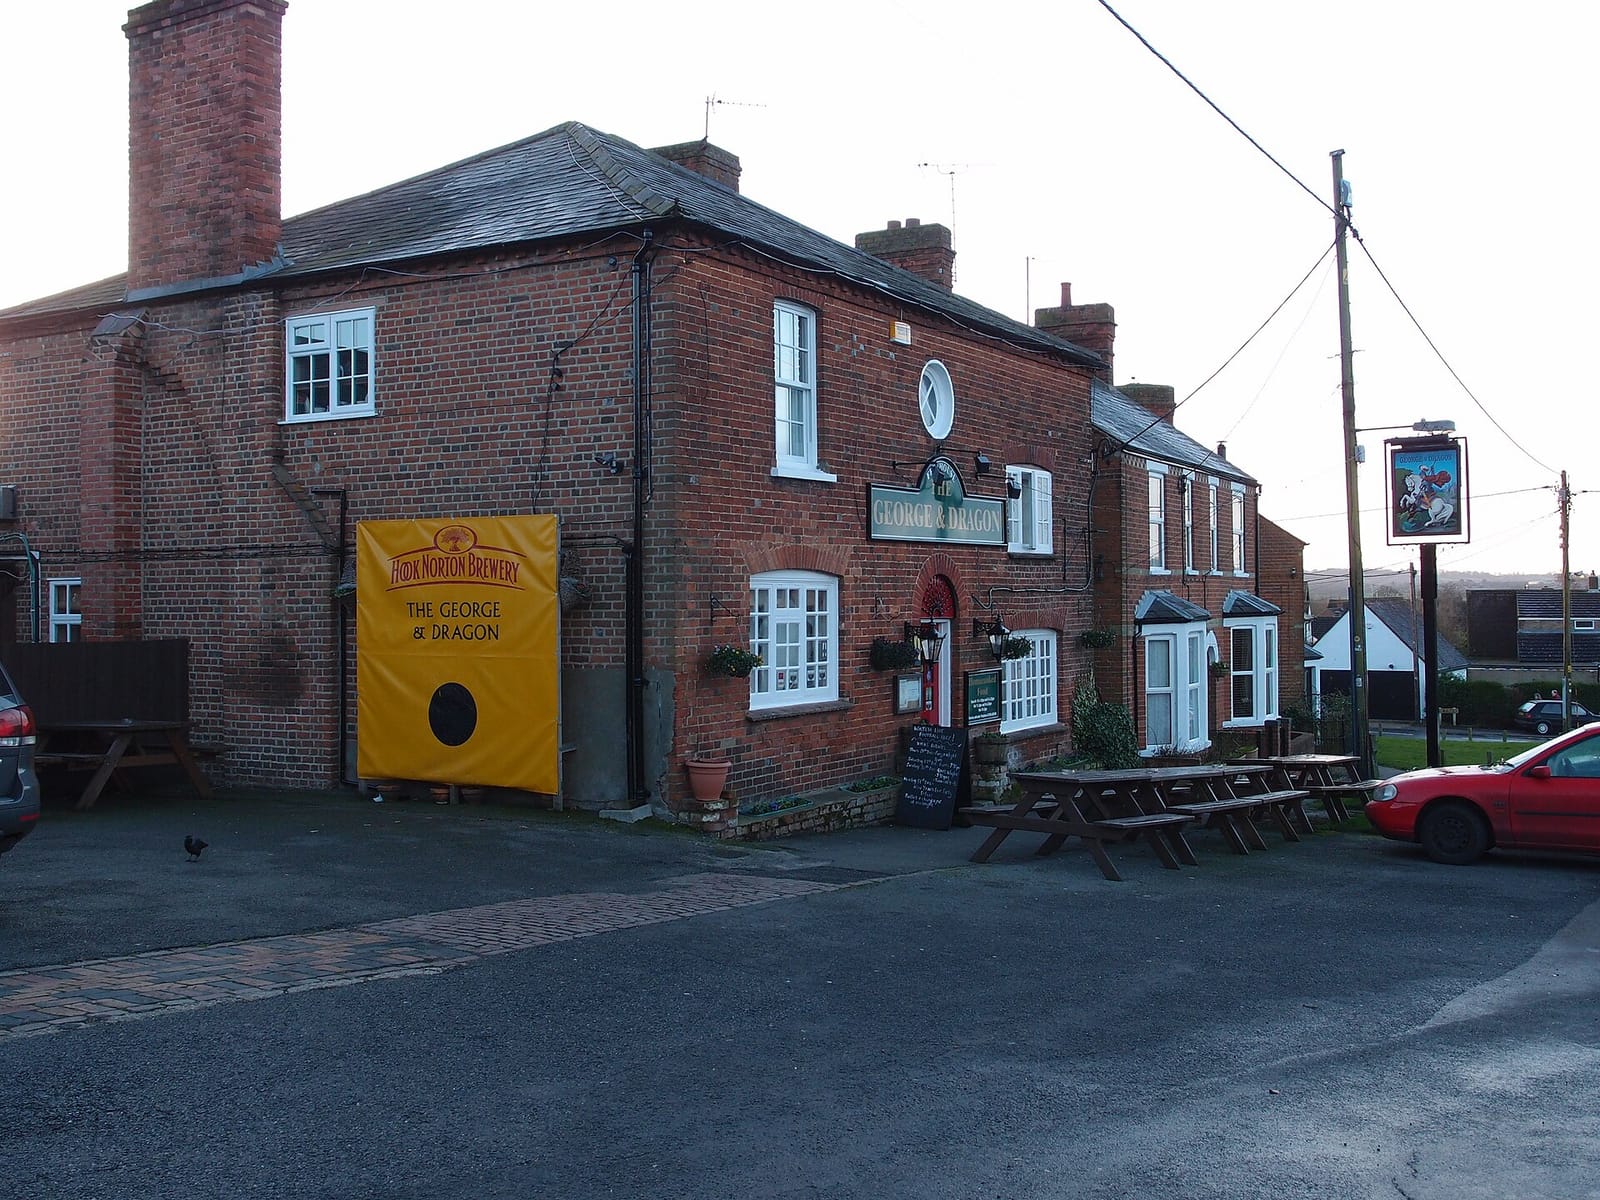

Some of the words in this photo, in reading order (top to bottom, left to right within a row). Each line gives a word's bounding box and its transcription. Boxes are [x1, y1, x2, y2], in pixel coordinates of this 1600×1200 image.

[873, 499, 932, 528] GEORGE
[935, 504, 945, 529] &
[948, 506, 1001, 532] DRAGON
[390, 559, 422, 584] HOOK
[422, 554, 468, 581] NORTON
[468, 553, 520, 585] BREWERY
[406, 602, 434, 618] THE
[439, 601, 501, 618] GEORGE
[413, 625, 426, 640] &
[432, 624, 499, 640] DRAGON
